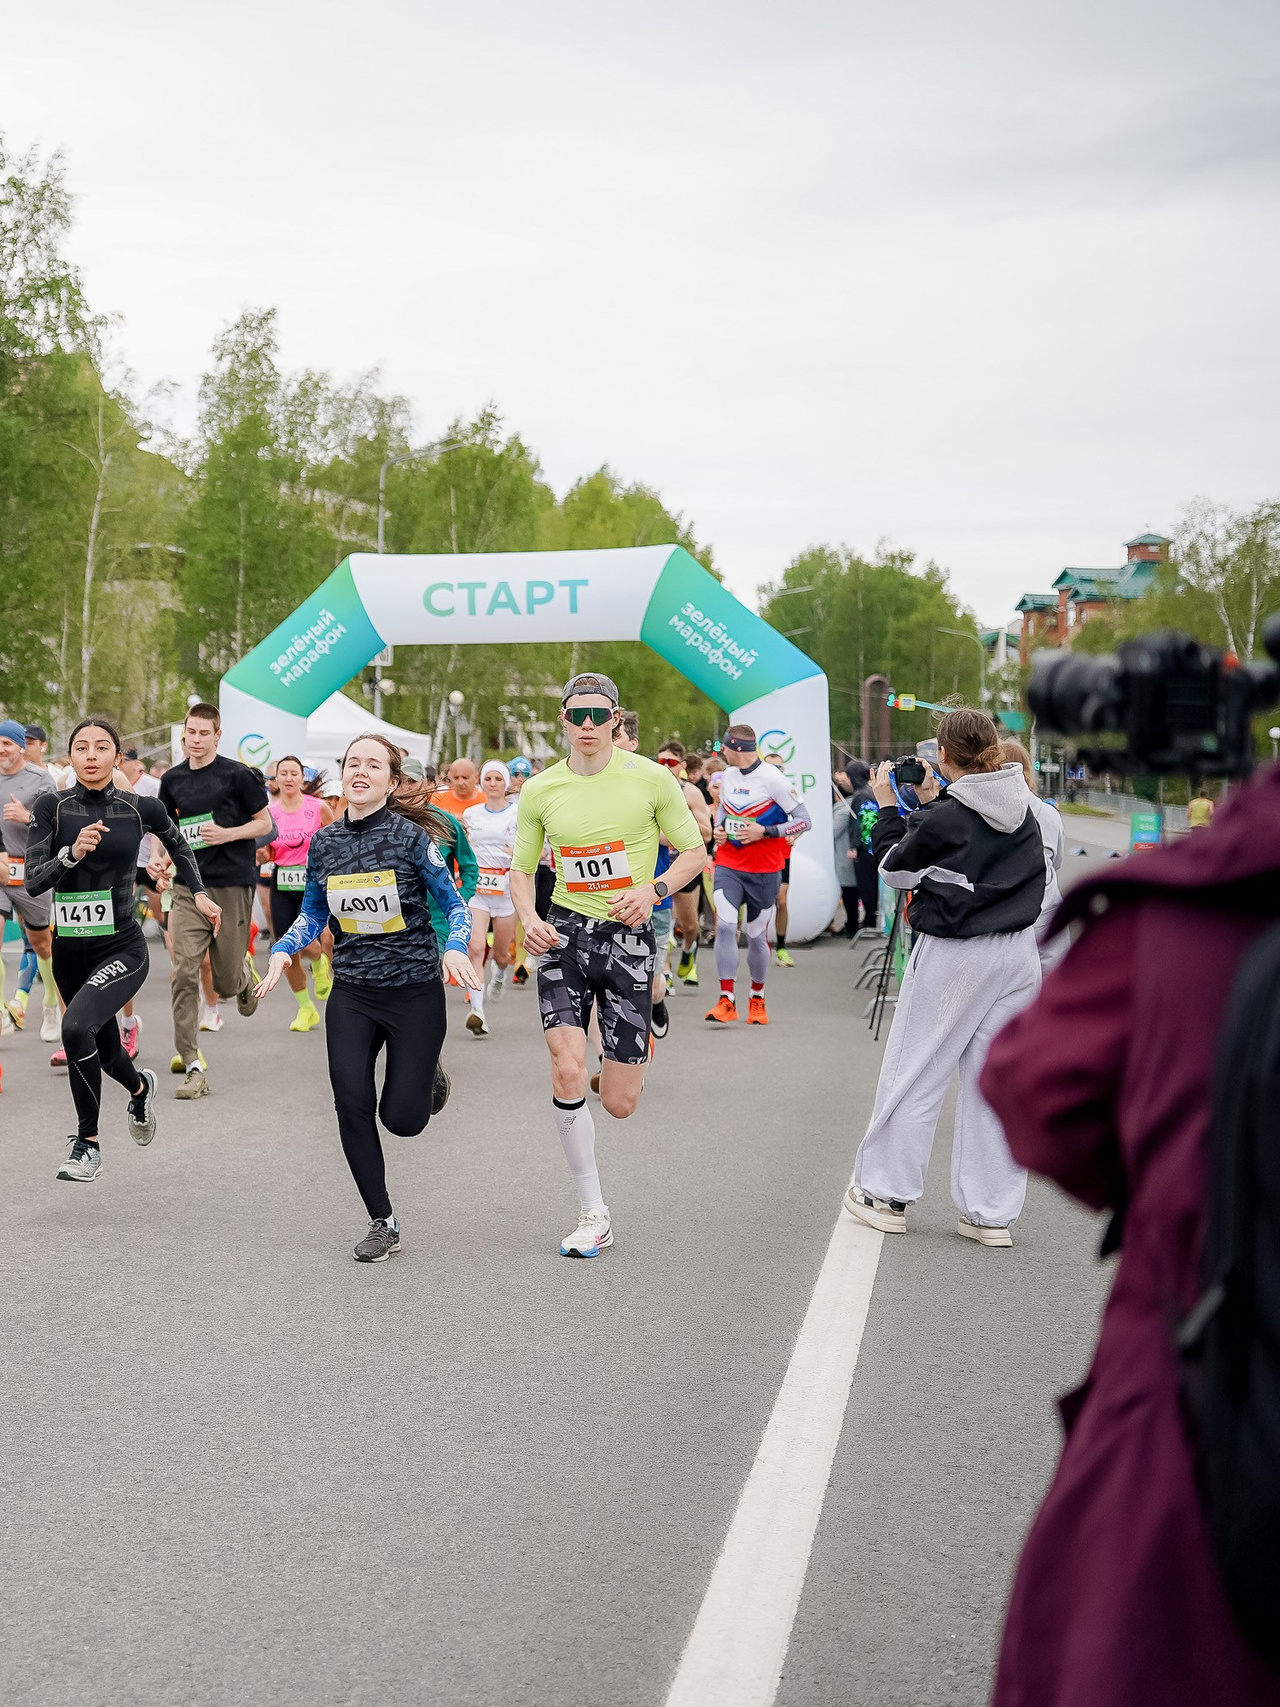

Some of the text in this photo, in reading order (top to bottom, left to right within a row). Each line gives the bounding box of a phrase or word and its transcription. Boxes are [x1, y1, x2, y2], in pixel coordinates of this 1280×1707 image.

[423, 579, 589, 617] СТАРТ
[269, 608, 336, 675] зелёный
[280, 623, 347, 687] марафон
[668, 615, 743, 680] марафон
[680, 602, 759, 668] зелёный
[575, 858, 614, 879] 101
[60, 904, 107, 923] 1419
[340, 895, 390, 913] 4001
